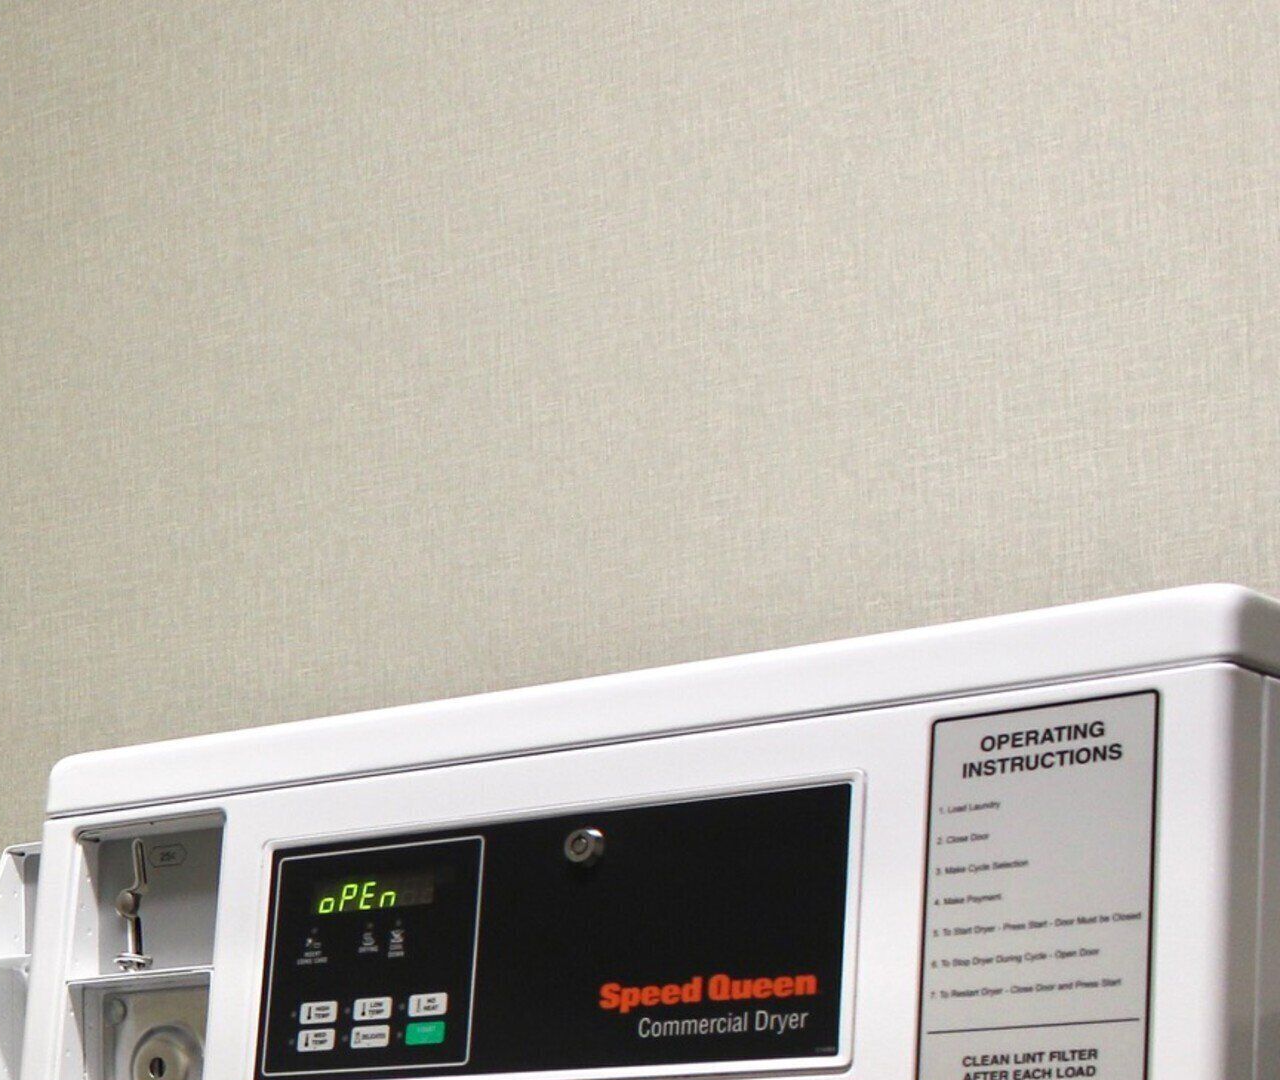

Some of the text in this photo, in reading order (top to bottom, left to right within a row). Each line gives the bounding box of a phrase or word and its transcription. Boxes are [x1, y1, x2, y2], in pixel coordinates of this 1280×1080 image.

[980, 720, 1106, 753] OPERATING
[962, 743, 1123, 780] INSTRUCTIONS
[947, 804, 967, 814] Load
[969, 801, 1001, 812] Laundry
[946, 836, 969, 844] Close
[970, 833, 990, 842] Door
[945, 866, 966, 875] Make
[968, 864, 990, 875] Cycle
[992, 859, 1029, 870] Selection
[943, 897, 964, 905] Make
[966, 893, 1002, 904] Payment
[942, 928, 951, 936] To
[953, 926, 973, 936] Start
[974, 925, 996, 935] Dryer
[1003, 921, 1026, 930] Press
[1028, 920, 1048, 930] Start
[1055, 917, 1075, 927] Door
[1076, 915, 1098, 925] Must
[1099, 914, 1110, 923] be
[1112, 911, 1142, 922] Closed
[941, 959, 951, 968] To
[952, 958, 971, 968] Stop
[972, 956, 994, 968] Dryer
[996, 954, 1022, 965] During
[1024, 952, 1047, 962] Cycle
[1055, 949, 1077, 959] Open
[1079, 947, 1100, 957] Door
[599, 973, 818, 1014] Speed Queen
[940, 990, 950, 999] To
[951, 988, 980, 998] Restart
[981, 987, 1003, 998] Dryer
[1010, 985, 1034, 994] Close
[1035, 982, 1056, 992] Door
[1057, 981, 1074, 991] and
[1075, 980, 1100, 989] Press
[1101, 978, 1123, 988] Start
[638, 1008, 810, 1039] Commercial Dryer
[962, 1048, 1098, 1068] CLEAN LINT FILTER
[1055, 1064, 1096, 1079] LOAD
